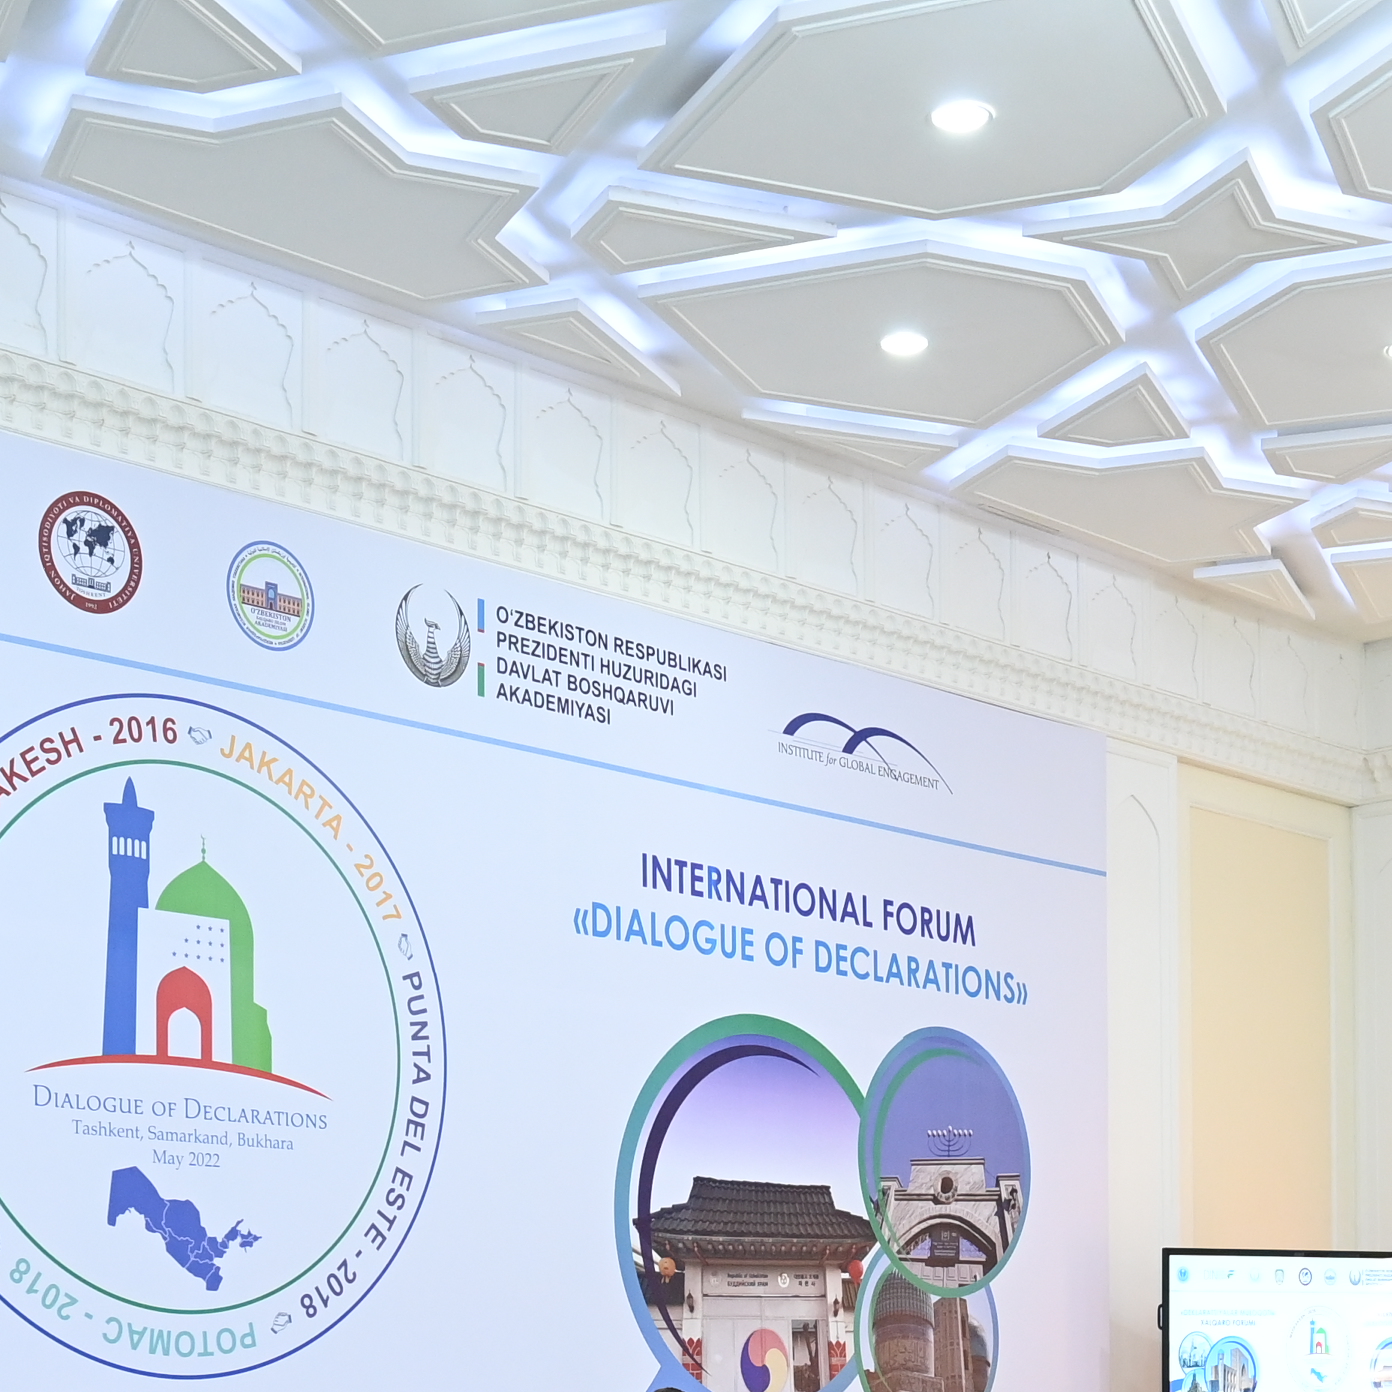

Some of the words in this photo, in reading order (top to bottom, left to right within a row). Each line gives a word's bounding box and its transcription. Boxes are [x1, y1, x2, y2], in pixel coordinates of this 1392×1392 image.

[68, 495, 80, 504] VA
[83, 495, 136, 544] DIPLOMATIYA
[49, 570, 76, 601] JAHON
[76, 587, 106, 598] TOSHKENT
[108, 548, 139, 609] UNIVERSITETI
[496, 630, 595, 672] PREZIDENTI
[600, 658, 697, 698] HUZURIDAGI
[613, 635, 728, 683] RESPUBLIKASI
[496, 656, 562, 688] DAVLAT
[567, 675, 675, 716] BOSHQARUVI
[496, 682, 611, 725] AKADEMIYASI
[109, 715, 179, 746] 2016
[778, 742, 824, 763] INSTITUTE
[825, 752, 837, 767] for
[839, 756, 876, 775] GLOBAL
[878, 765, 940, 790] ENGAGEMENT
[219, 733, 345, 842] JAKARTA
[354, 853, 404, 926] 2017
[641, 852, 873, 929] INTERNATIONAL
[882, 898, 977, 947] FORUM
[573, 901, 754, 963] «DIALOGUE
[765, 931, 804, 969] OF
[814, 940, 1029, 1006] DECLARATIONS»
[401, 971, 432, 1086] PUNTA
[71, 1119, 144, 1142] Tashkent,
[147, 1125, 233, 1148] Samarkand,
[237, 1132, 294, 1151] Bukhara
[400, 1096, 430, 1158] DEL
[152, 1149, 184, 1170] May
[188, 1151, 221, 1168] 2022
[364, 1167, 414, 1252] ESTE
[9, 1257, 80, 1322] 2018
[300, 1267, 359, 1320] 2018
[101, 1314, 258, 1359] POTOMAC
